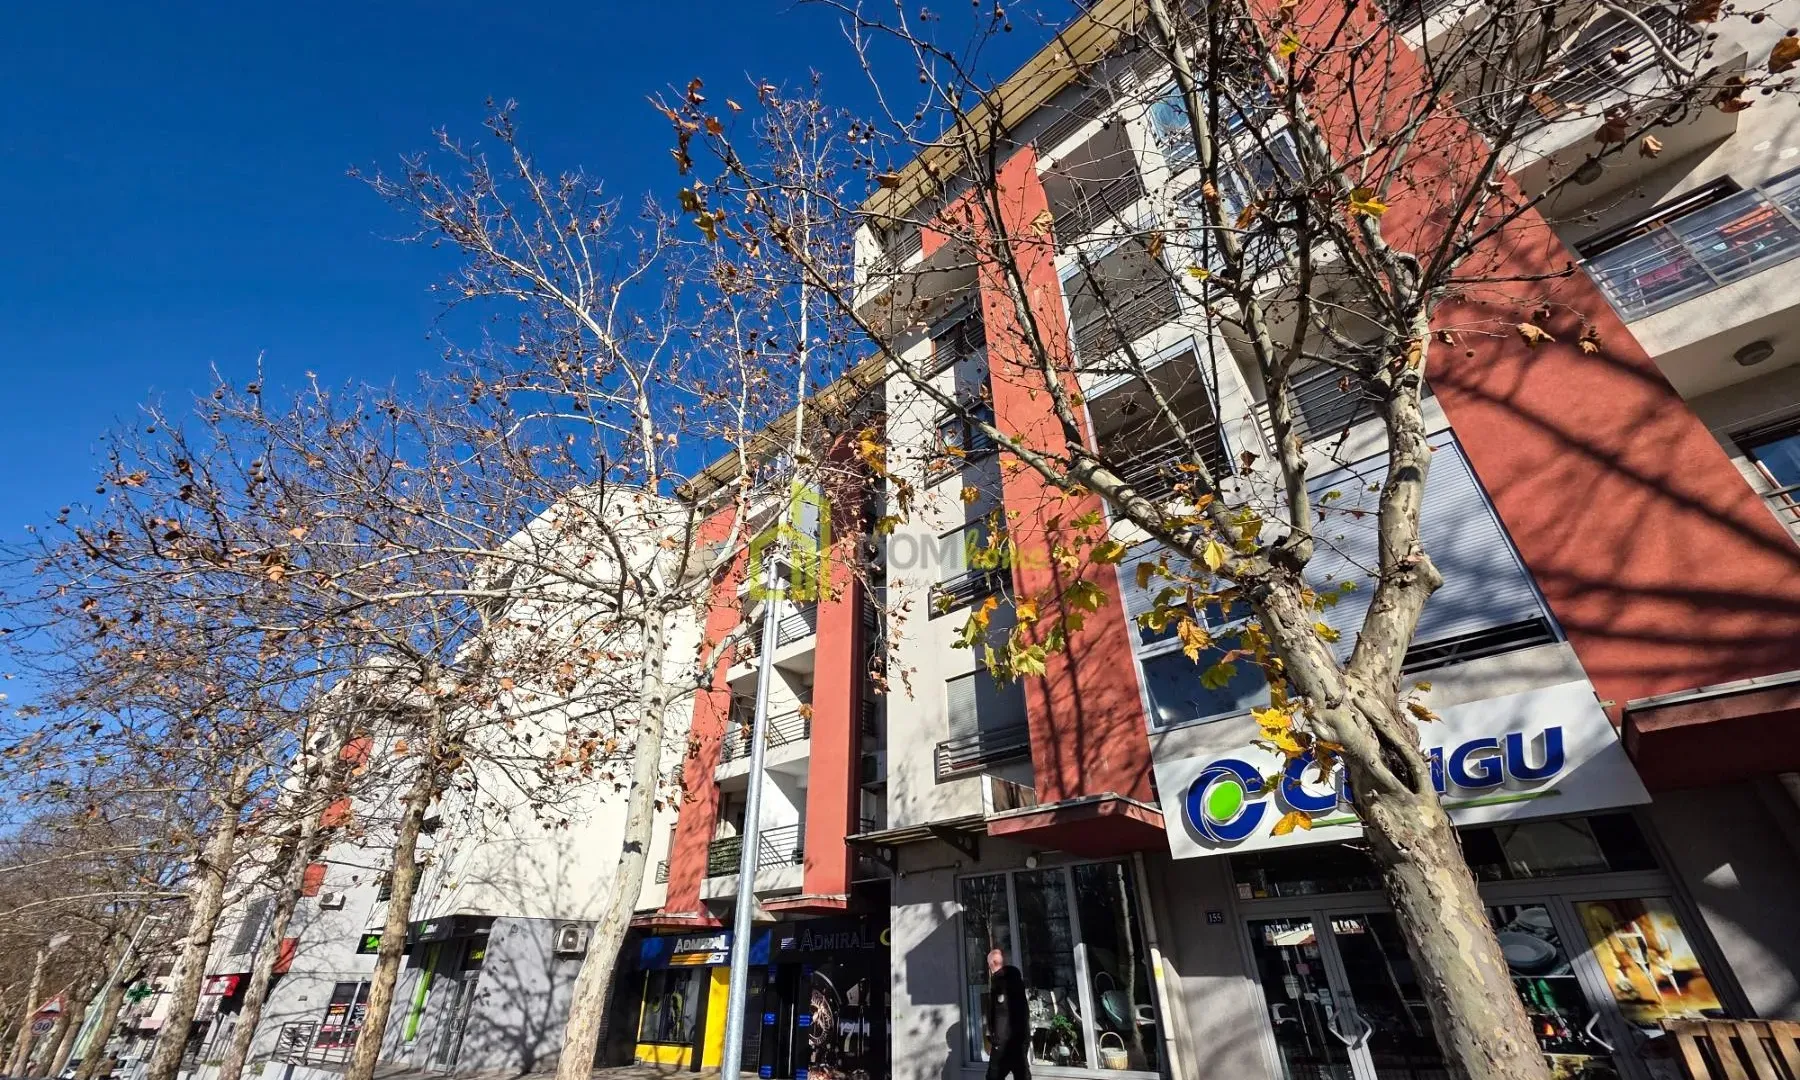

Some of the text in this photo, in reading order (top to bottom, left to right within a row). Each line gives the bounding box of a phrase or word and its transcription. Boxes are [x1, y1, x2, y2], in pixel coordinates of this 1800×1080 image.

[1282, 726, 1565, 812] CGU
[1208, 913, 1222, 923] 155
[674, 934, 729, 953] ADMIRAL
[799, 924, 875, 951] ADMIRAL
[35, 1022, 50, 1031] 30
